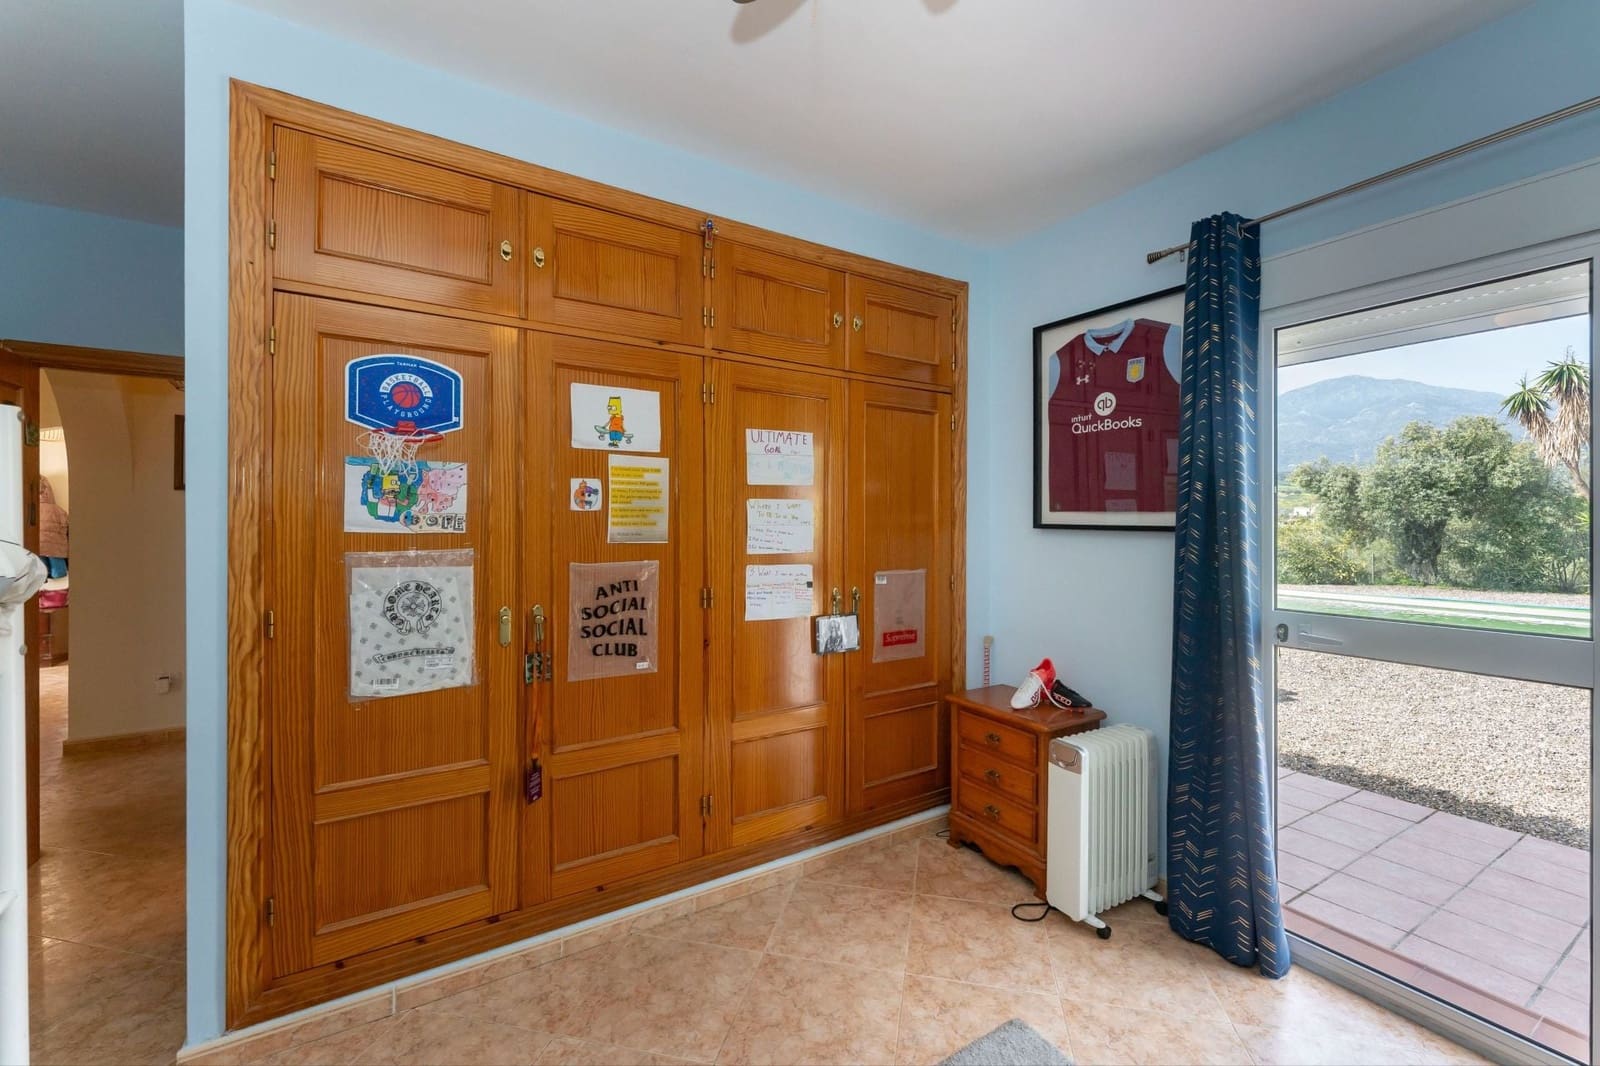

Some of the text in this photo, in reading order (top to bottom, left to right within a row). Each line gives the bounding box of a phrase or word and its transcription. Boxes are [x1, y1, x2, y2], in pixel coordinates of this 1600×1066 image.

[381, 374, 431, 395] BASKETBALL
[380, 394, 432, 418] PLAYGROUND
[1071, 413, 1092, 423] intuit
[1071, 416, 1142, 434] QuickBooks
[750, 429, 808, 446] ULTIMATE
[595, 580, 639, 600] ANTI
[581, 597, 647, 620] SOCIAL
[580, 618, 648, 639] SOCIAL
[592, 643, 638, 657] CLUB
